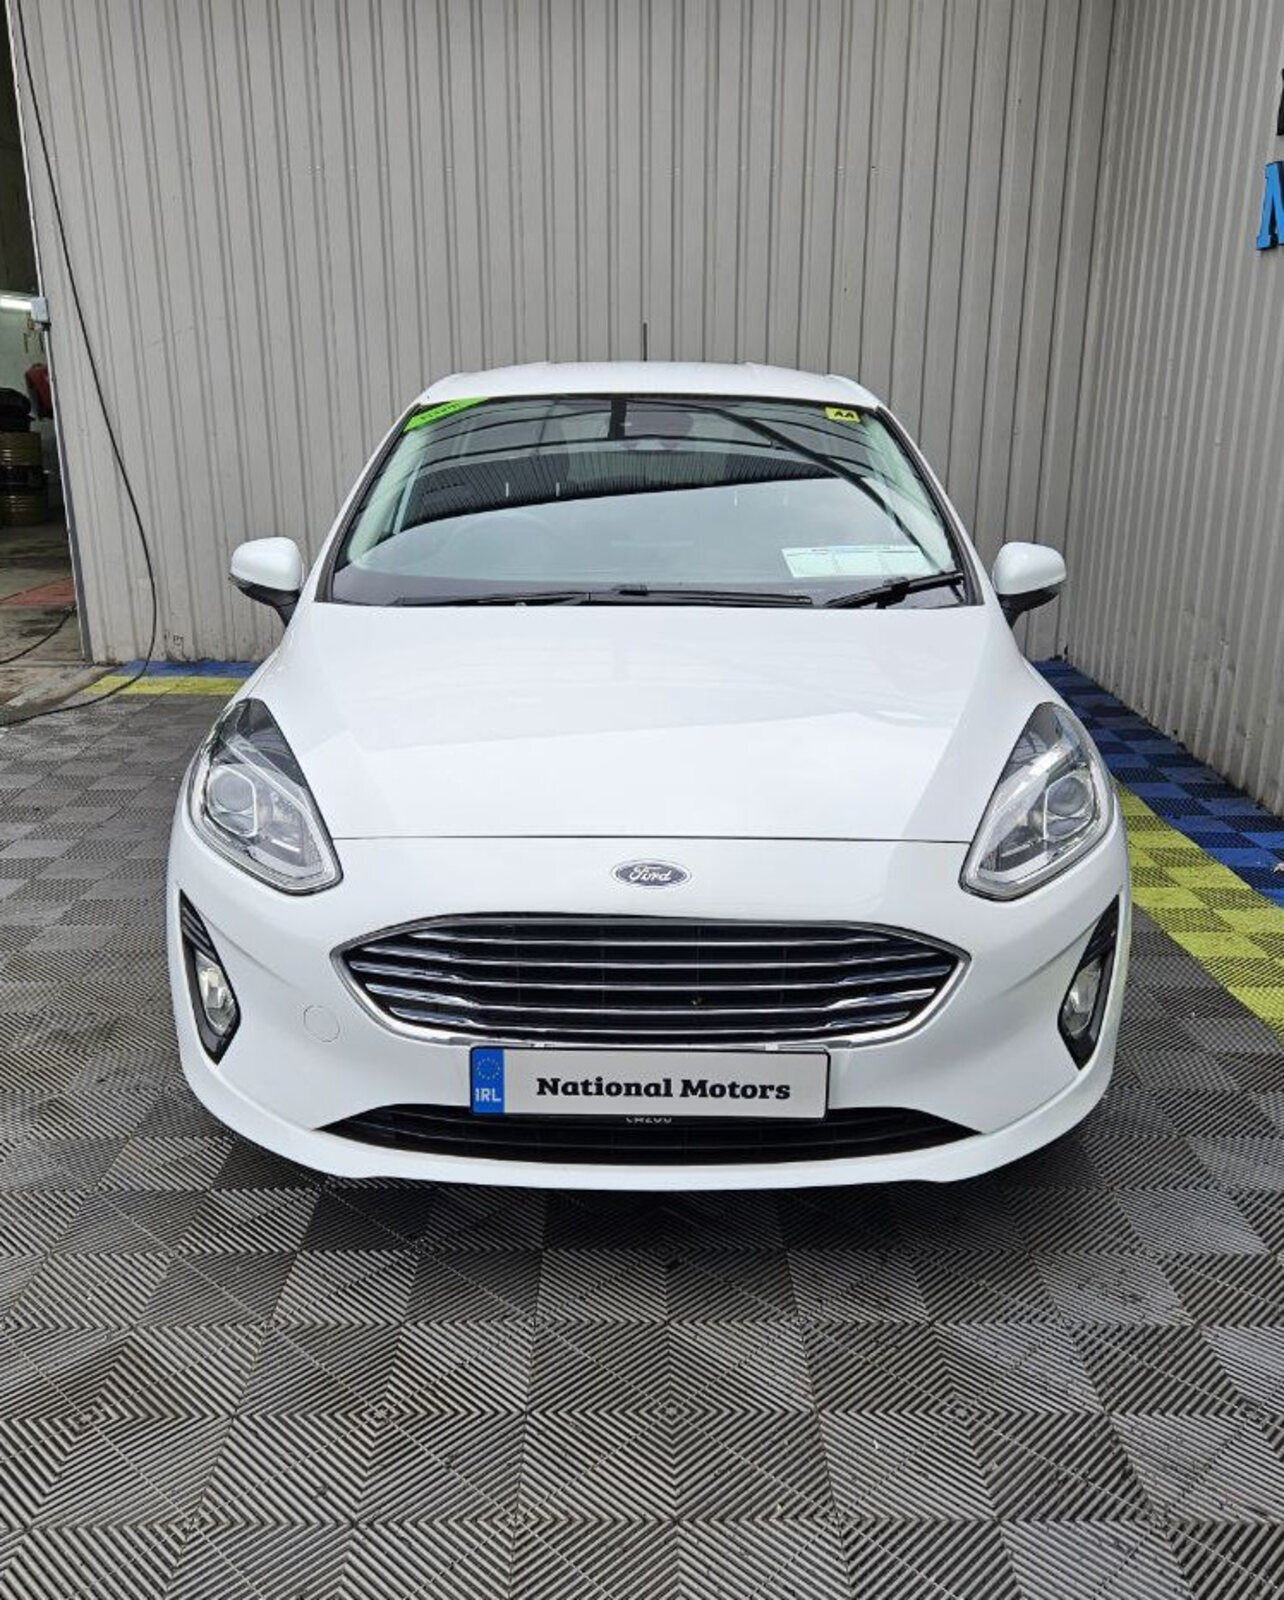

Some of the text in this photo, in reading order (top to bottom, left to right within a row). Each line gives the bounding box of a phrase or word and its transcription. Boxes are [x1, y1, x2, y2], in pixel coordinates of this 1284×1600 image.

[629, 865, 672, 881] Ford
[475, 1087, 502, 1102] IRL
[536, 1076, 791, 1100] National Motors
